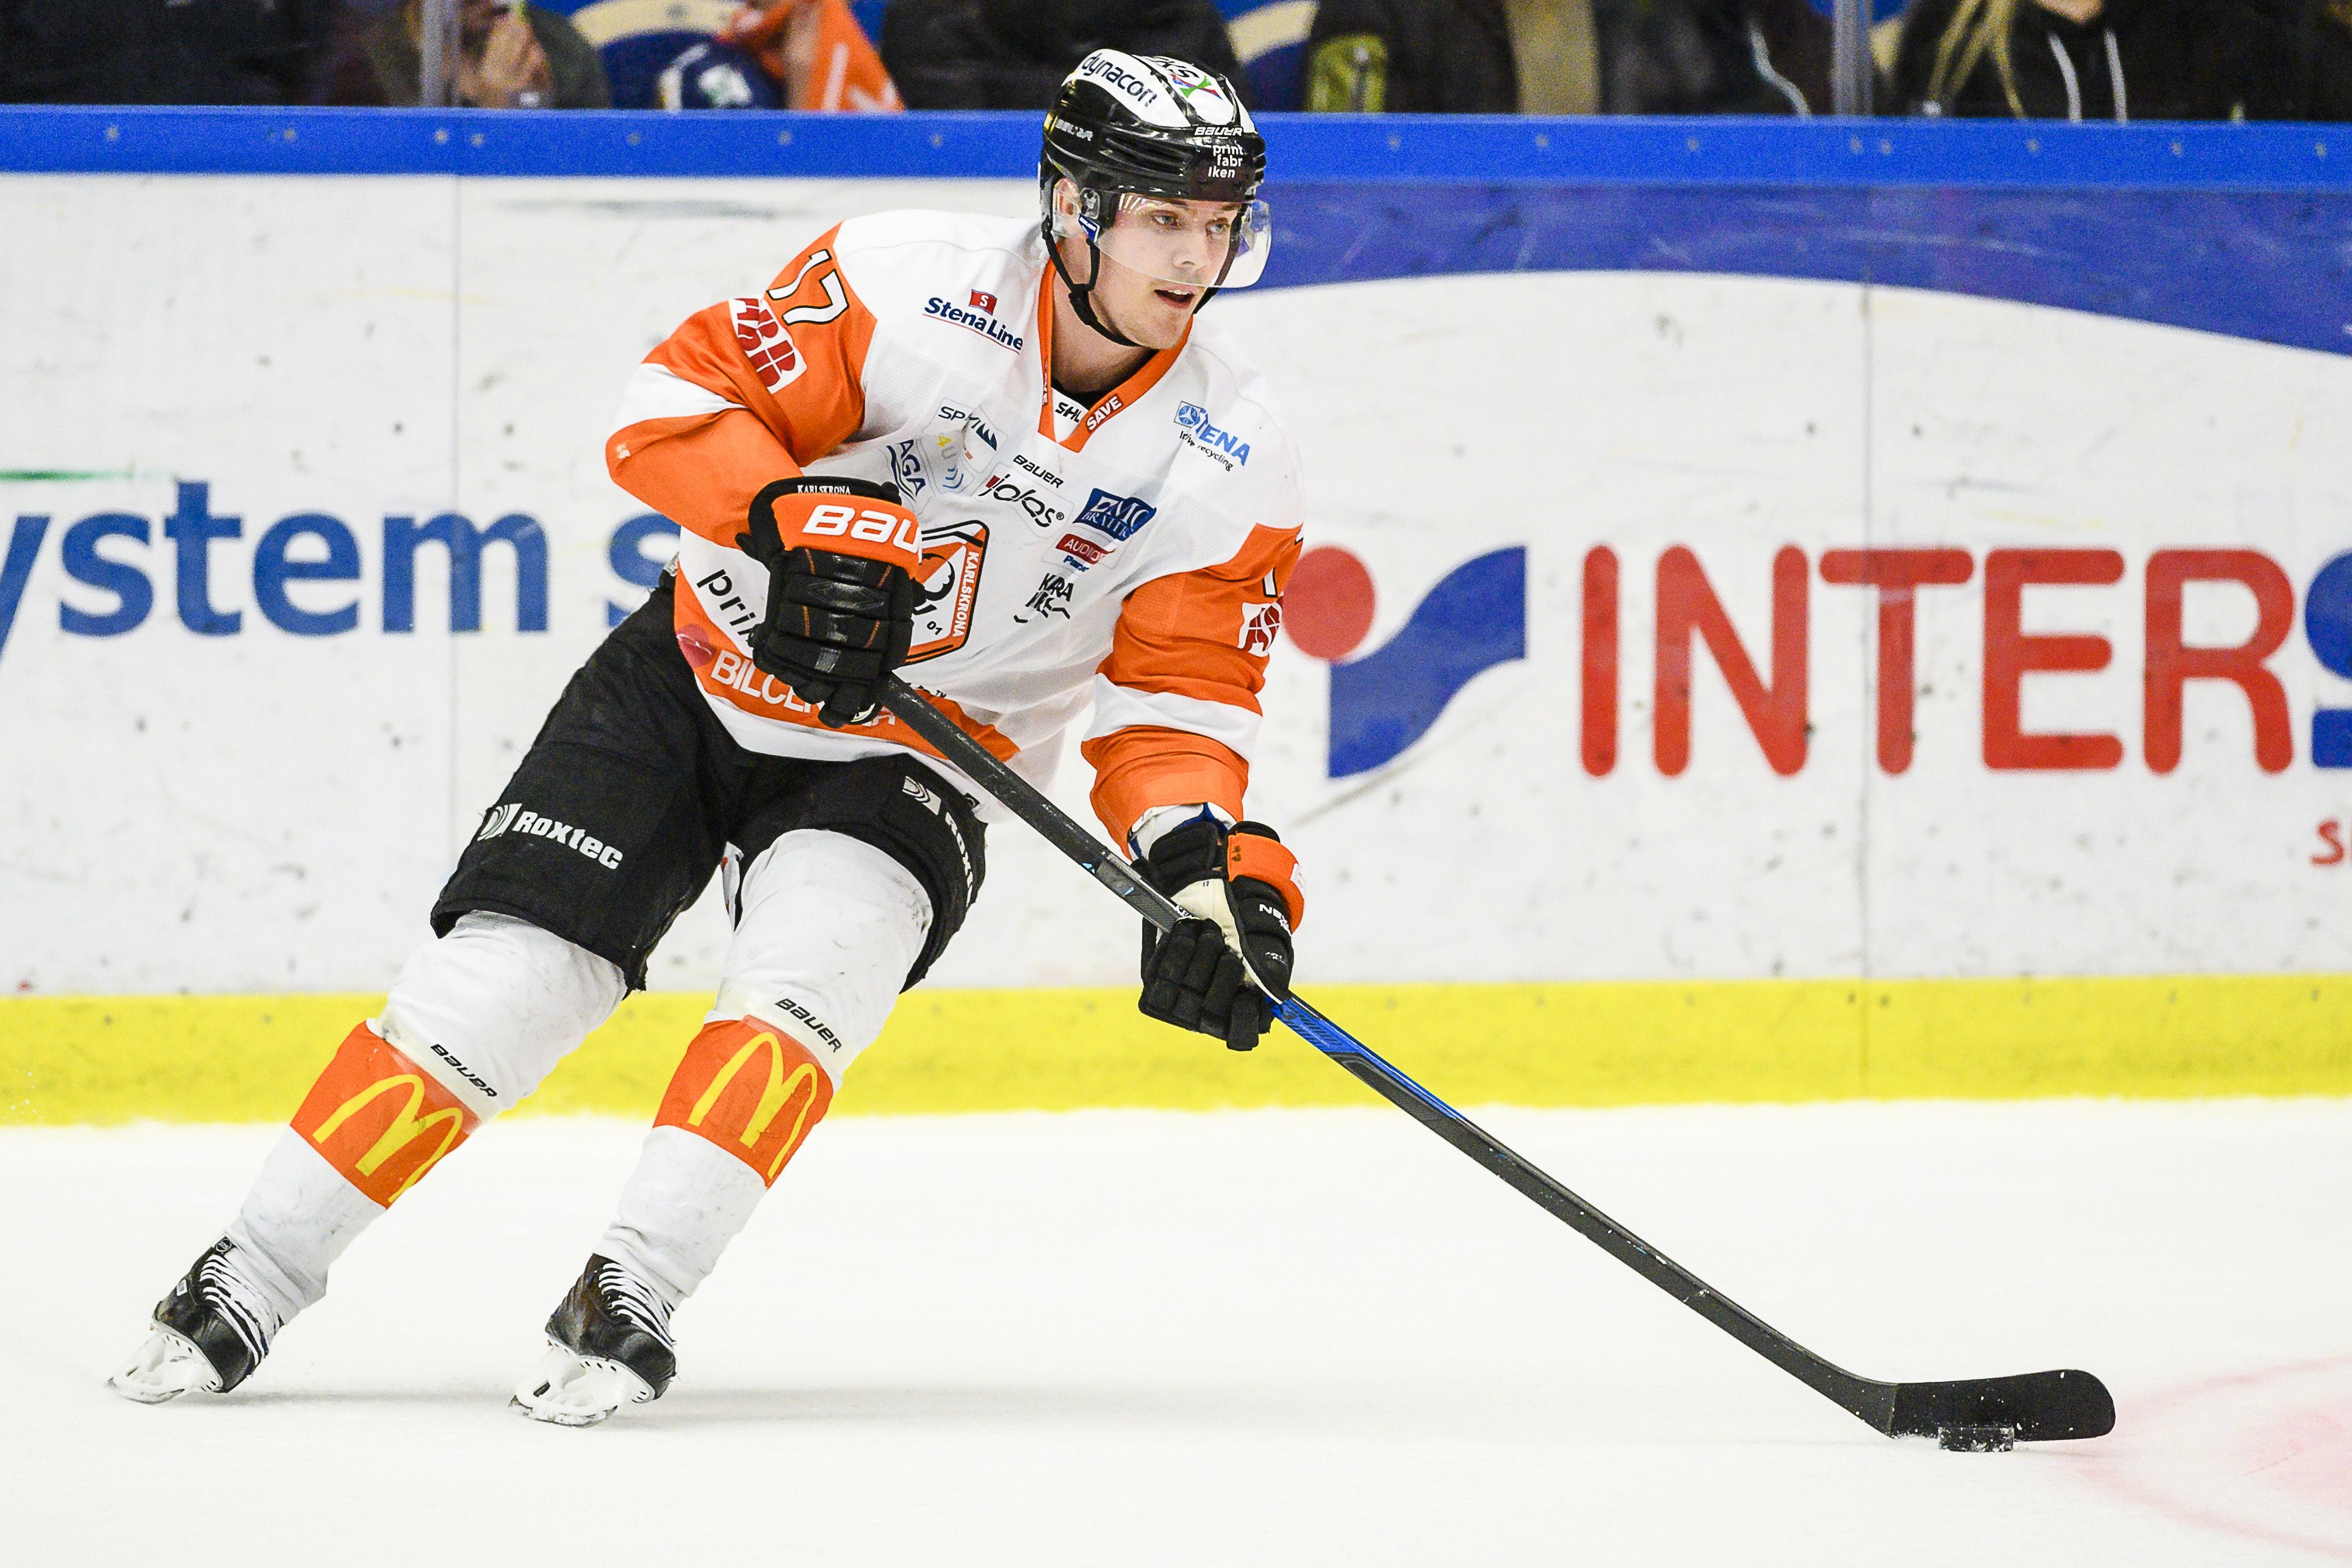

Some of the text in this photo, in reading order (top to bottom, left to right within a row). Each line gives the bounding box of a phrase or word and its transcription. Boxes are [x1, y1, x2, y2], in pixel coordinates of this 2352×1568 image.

[1217, 154, 1243, 167] fabr
[1055, 402, 1082, 423] SHL
[1087, 396, 1122, 430] SAVE
[797, 484, 851, 495] KARLSKRONA
[952, 551, 980, 638] KARLSKRONA
[926, 620, 943, 635] 01
[512, 811, 623, 870] Roxtec
